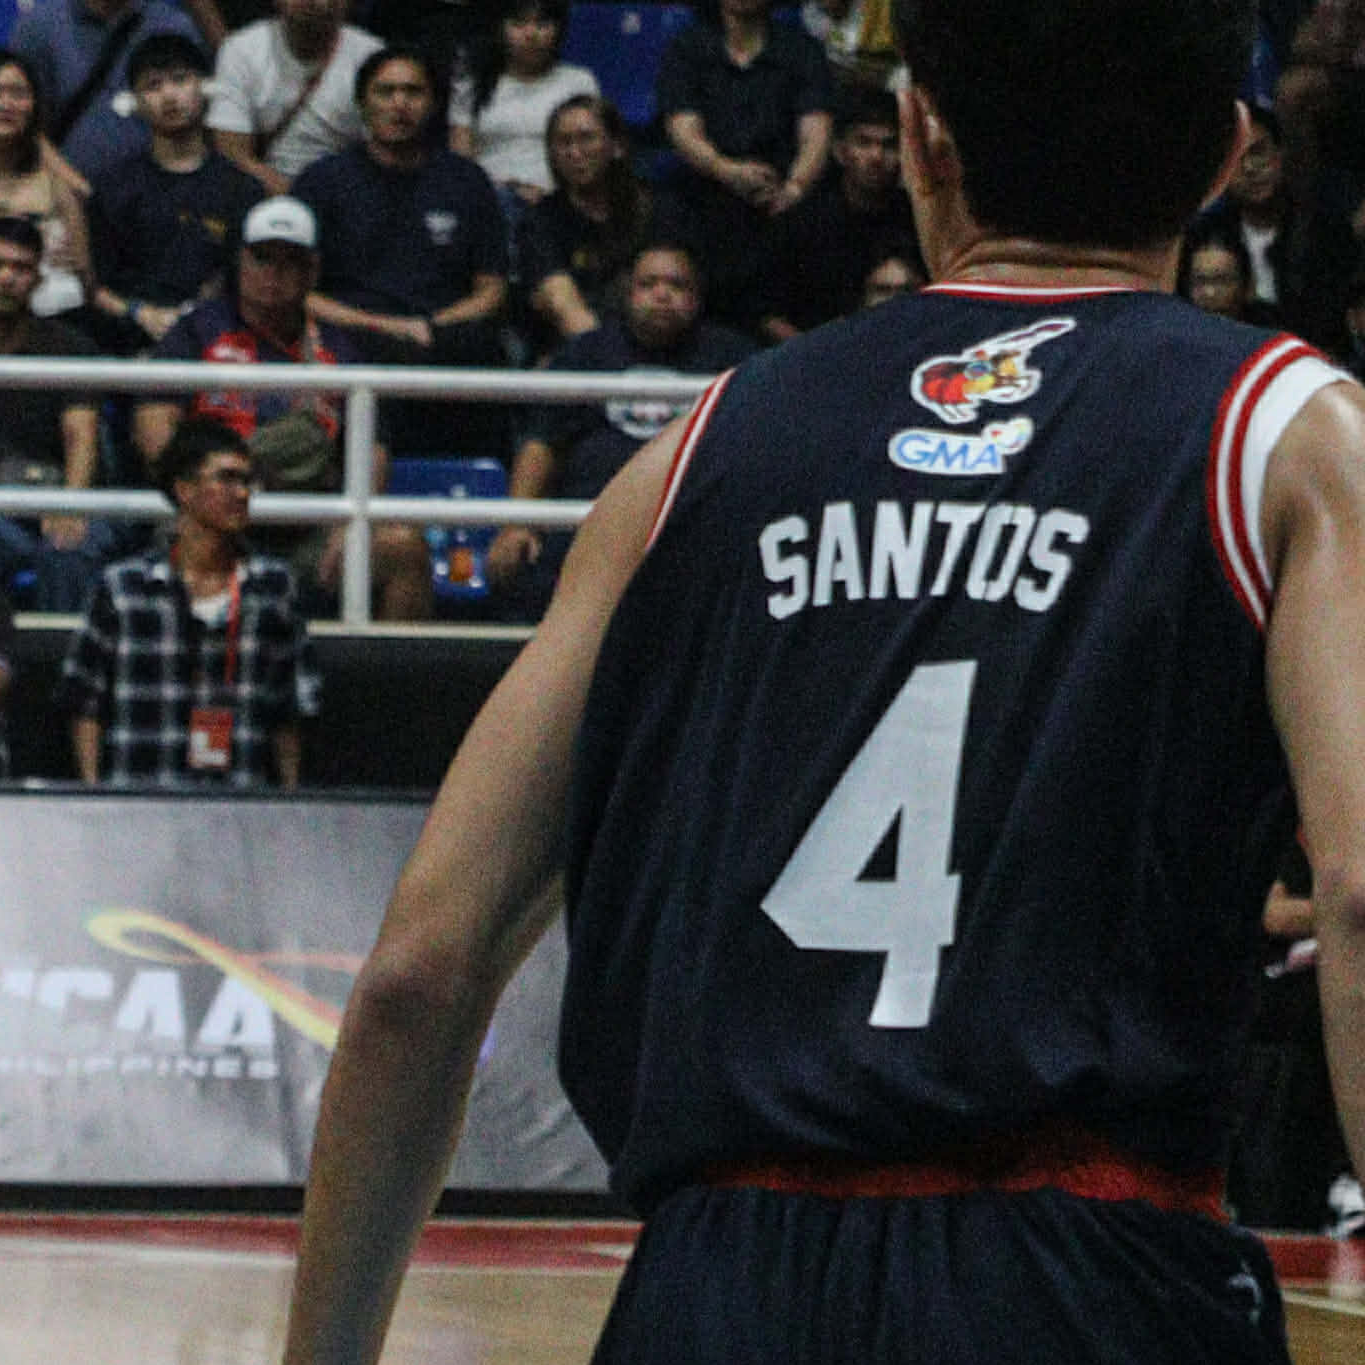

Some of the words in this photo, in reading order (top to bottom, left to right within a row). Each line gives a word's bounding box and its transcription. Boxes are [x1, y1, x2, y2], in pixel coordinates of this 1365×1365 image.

[896, 433, 999, 470] GMA
[759, 500, 1090, 620] SANTOS
[759, 658, 978, 1028] 4
